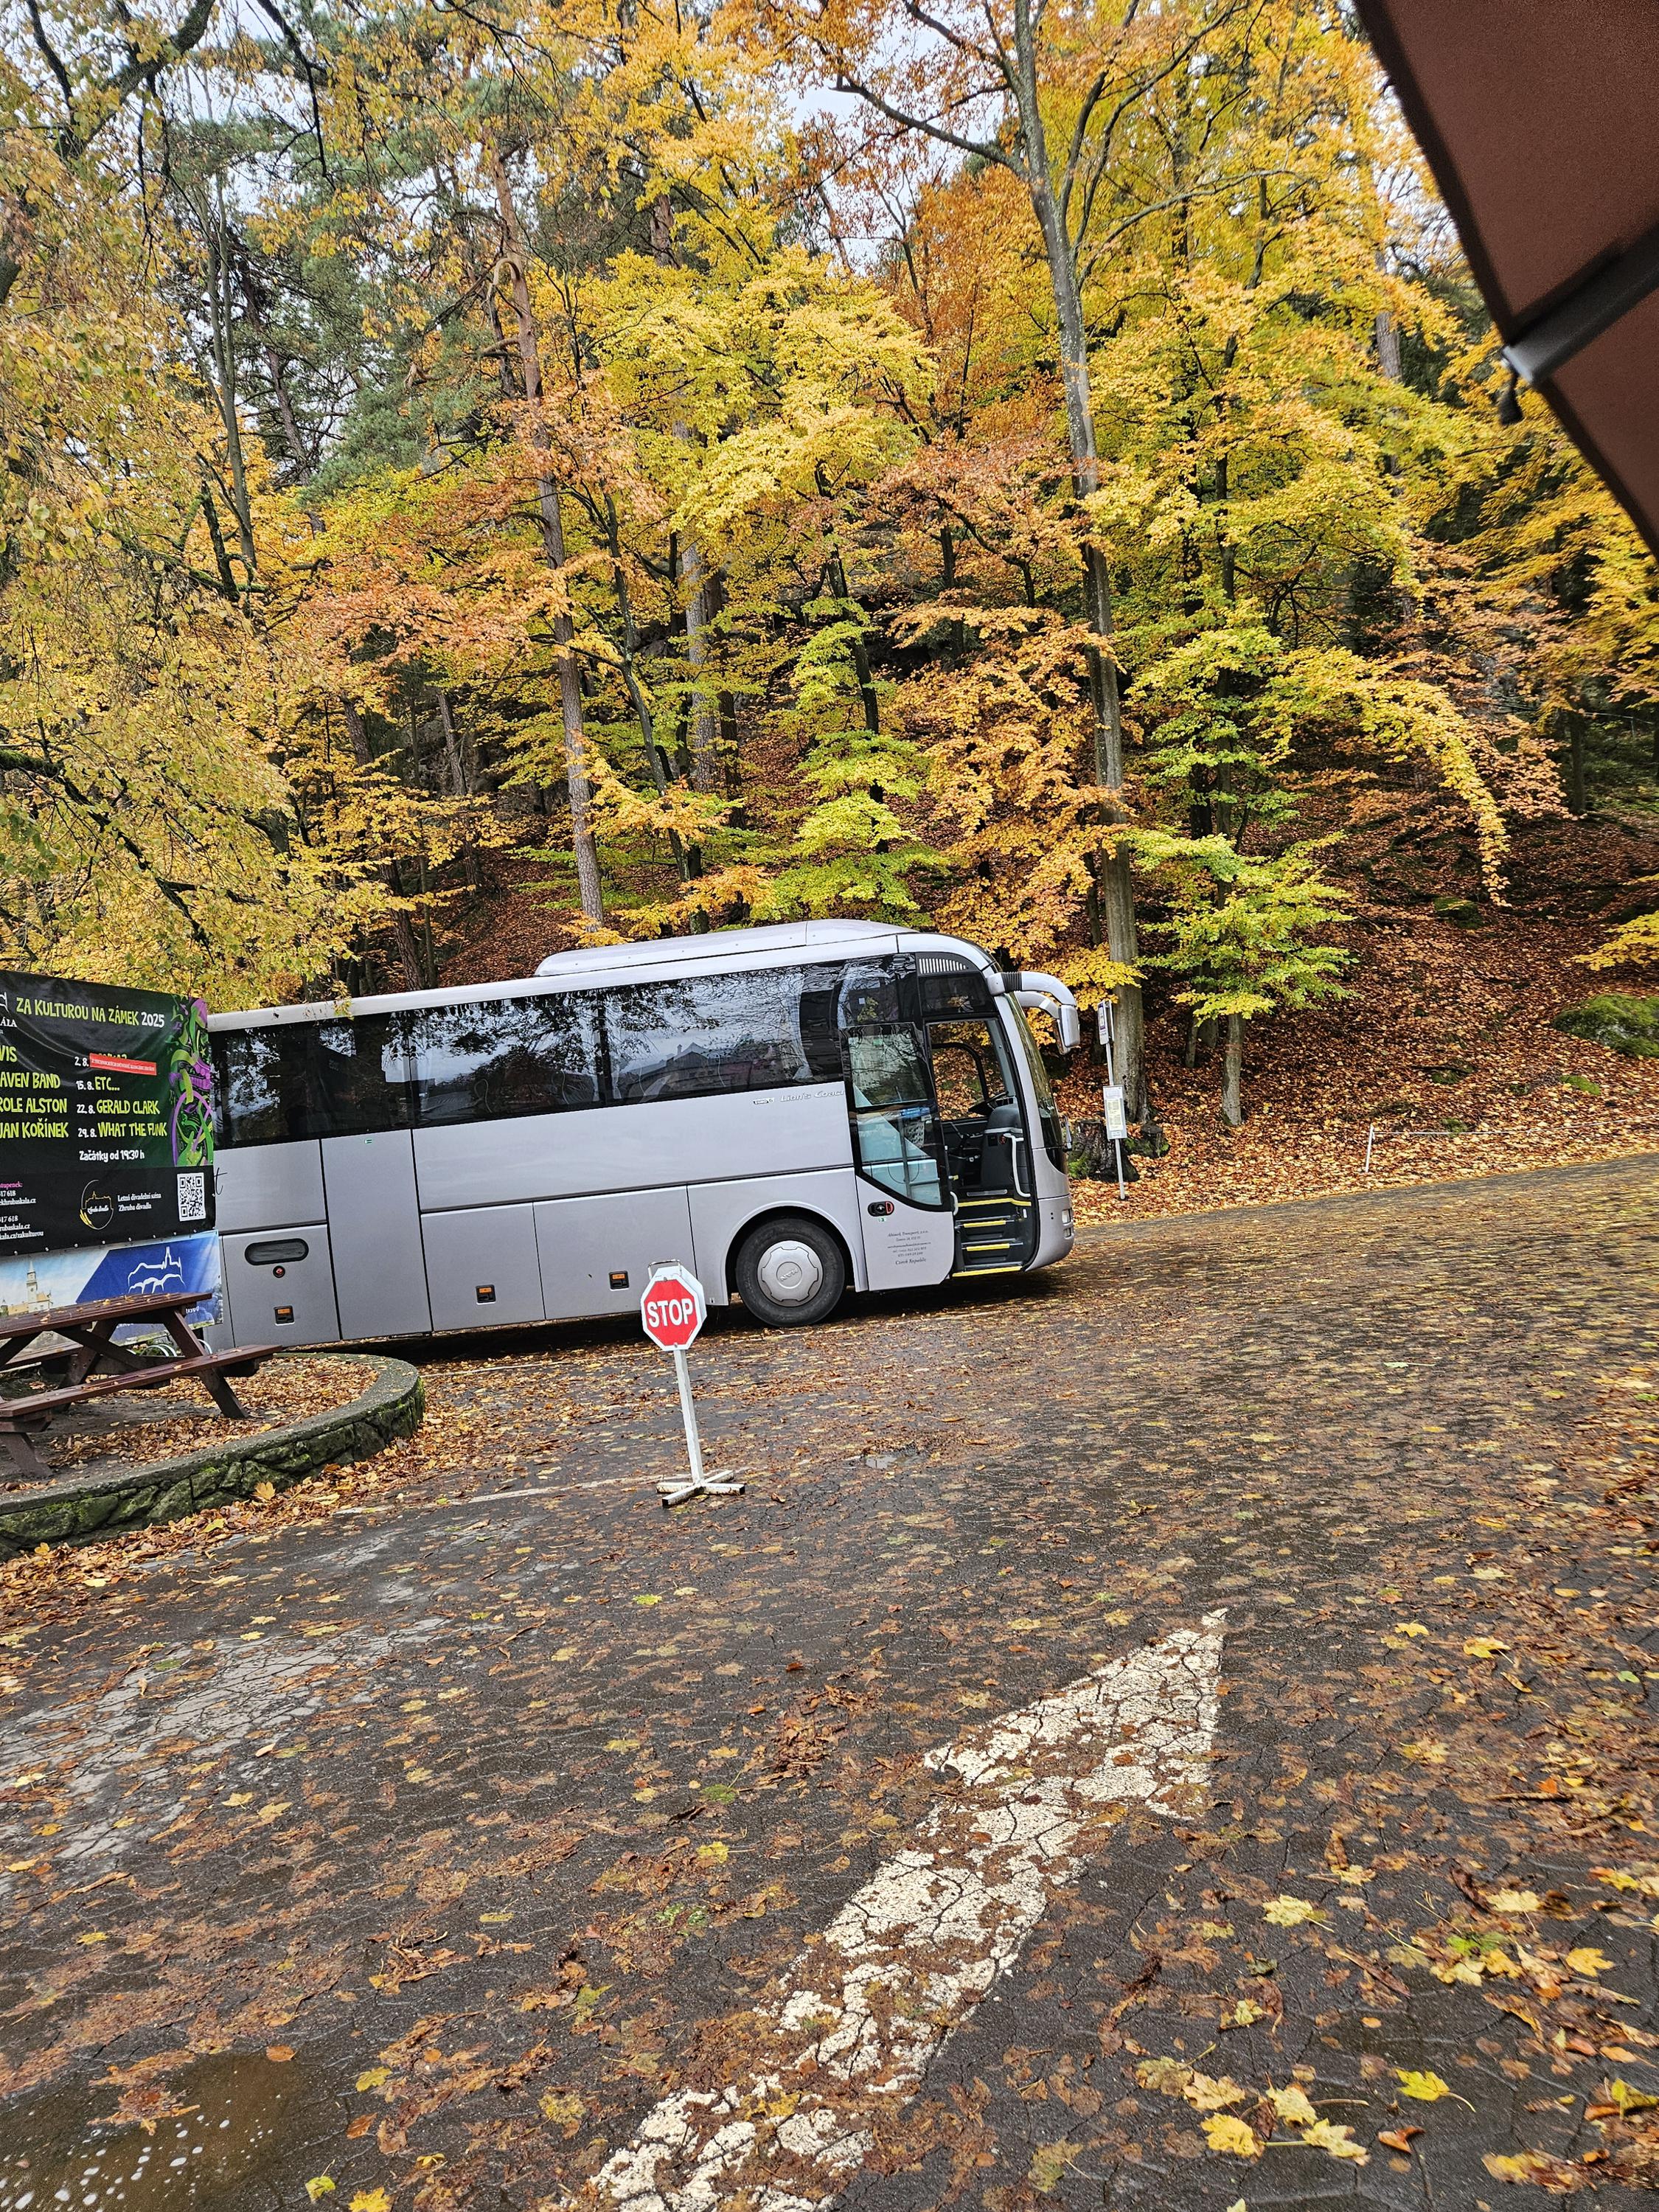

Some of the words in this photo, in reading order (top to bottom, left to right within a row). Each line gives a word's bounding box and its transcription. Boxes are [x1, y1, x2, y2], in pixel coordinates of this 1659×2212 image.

[16, 997, 32, 1015] ZA
[35, 999, 88, 1020] KULTUROU
[91, 1006, 105, 1022] NA
[108, 1005, 139, 1026] ZÁMEK
[141, 1012, 165, 1028] 2025
[32, 1072, 60, 1089] BAND
[94, 1077, 120, 1091] ETC...
[26, 1097, 67, 1113] ALSTON
[780, 1092, 812, 1102] Lion's
[97, 1099, 131, 1114] GERALD
[133, 1100, 161, 1115] CLARK
[21, 1117, 69, 1138] KOŘÍNEK
[97, 1121, 126, 1137] WHAT
[128, 1122, 147, 1137] THE
[147, 1122, 167, 1137] FUNK
[79, 1150, 108, 1163] Začátky
[110, 1150, 119, 1160] od
[120, 1150, 139, 1161] 19:30
[139, 1150, 145, 1160] h
[647, 1298, 693, 1328] STOP
